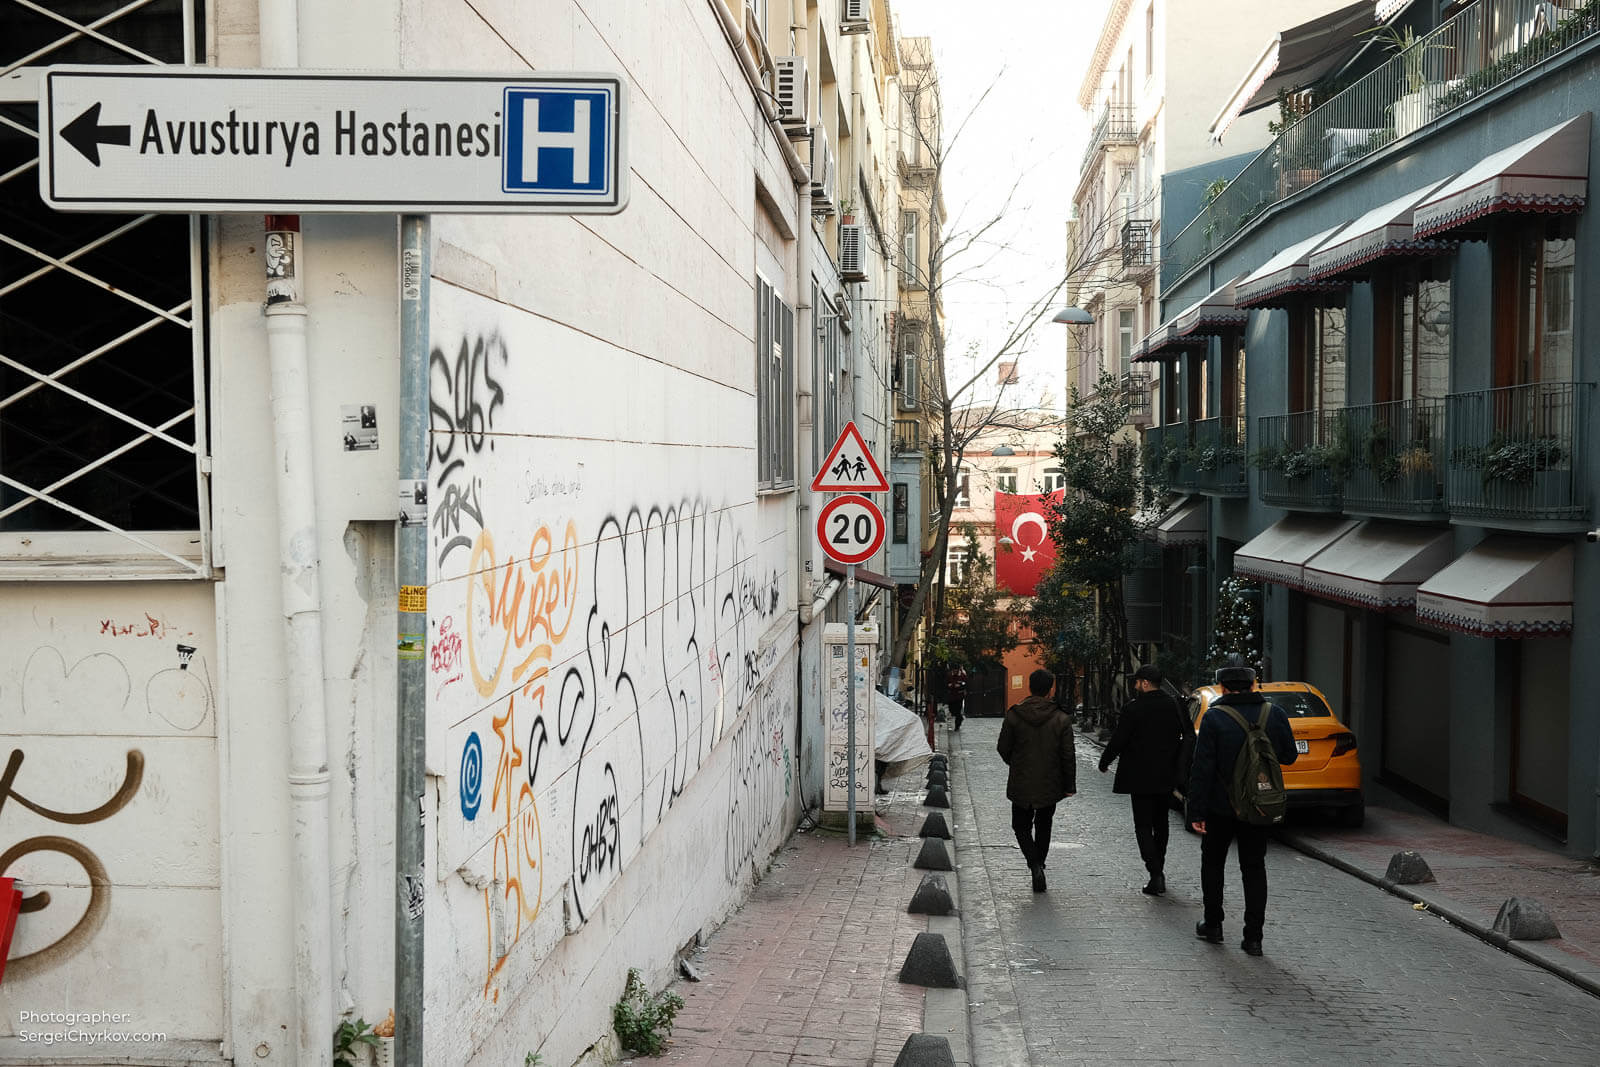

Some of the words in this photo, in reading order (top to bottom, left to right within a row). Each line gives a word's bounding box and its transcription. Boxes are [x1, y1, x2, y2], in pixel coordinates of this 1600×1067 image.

[140, 109, 319, 167] Avusturya
[336, 110, 501, 157] Hastanesi
[521, 98, 591, 184] H
[833, 514, 872, 544] 20
